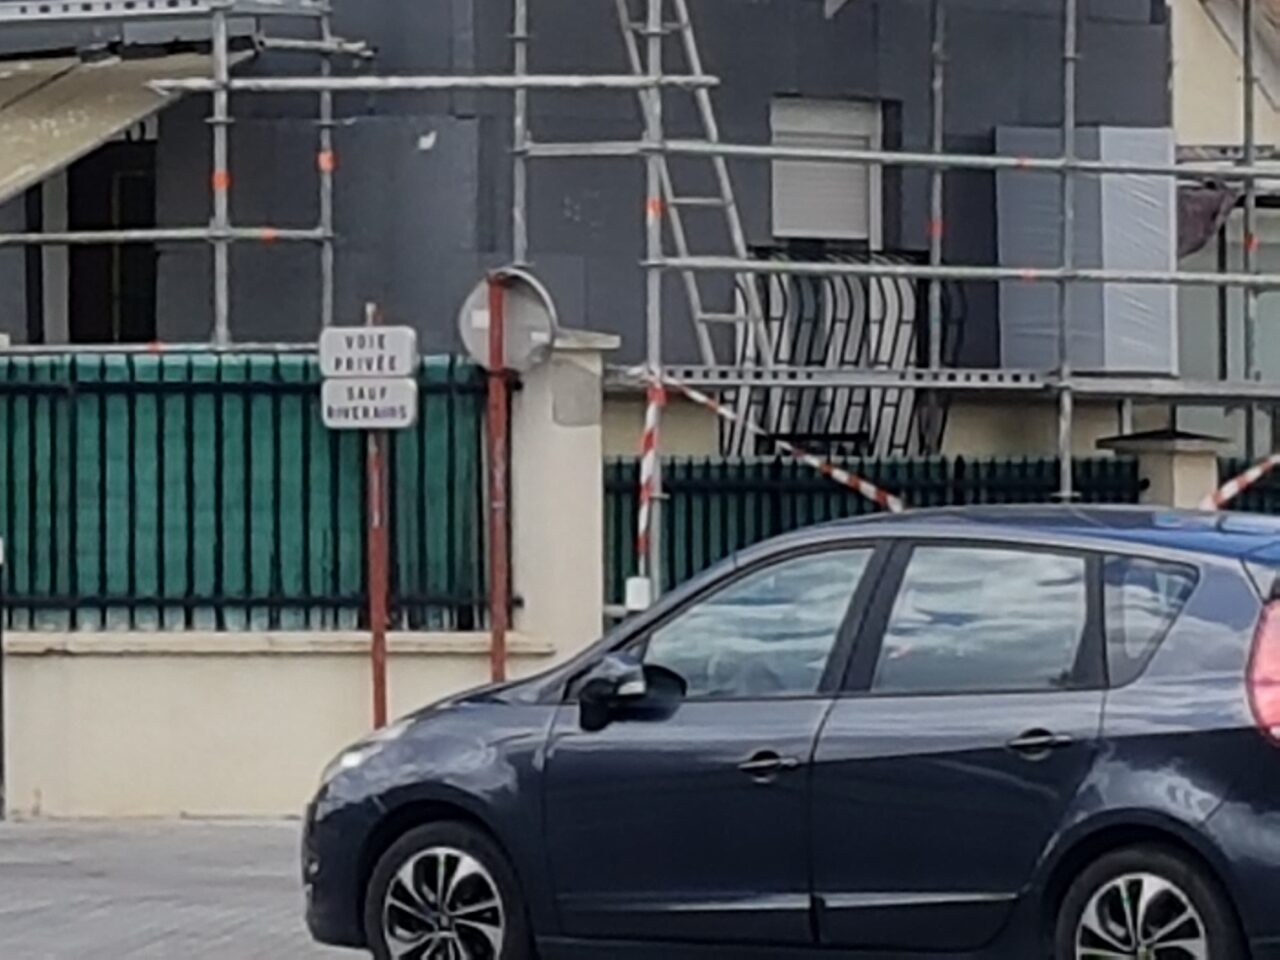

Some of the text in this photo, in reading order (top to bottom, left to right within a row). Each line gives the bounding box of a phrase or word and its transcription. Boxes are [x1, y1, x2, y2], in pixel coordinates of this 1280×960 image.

[345, 334, 385, 349] VOIE
[335, 354, 396, 370] PRIVÉE
[347, 387, 387, 400] SAUF
